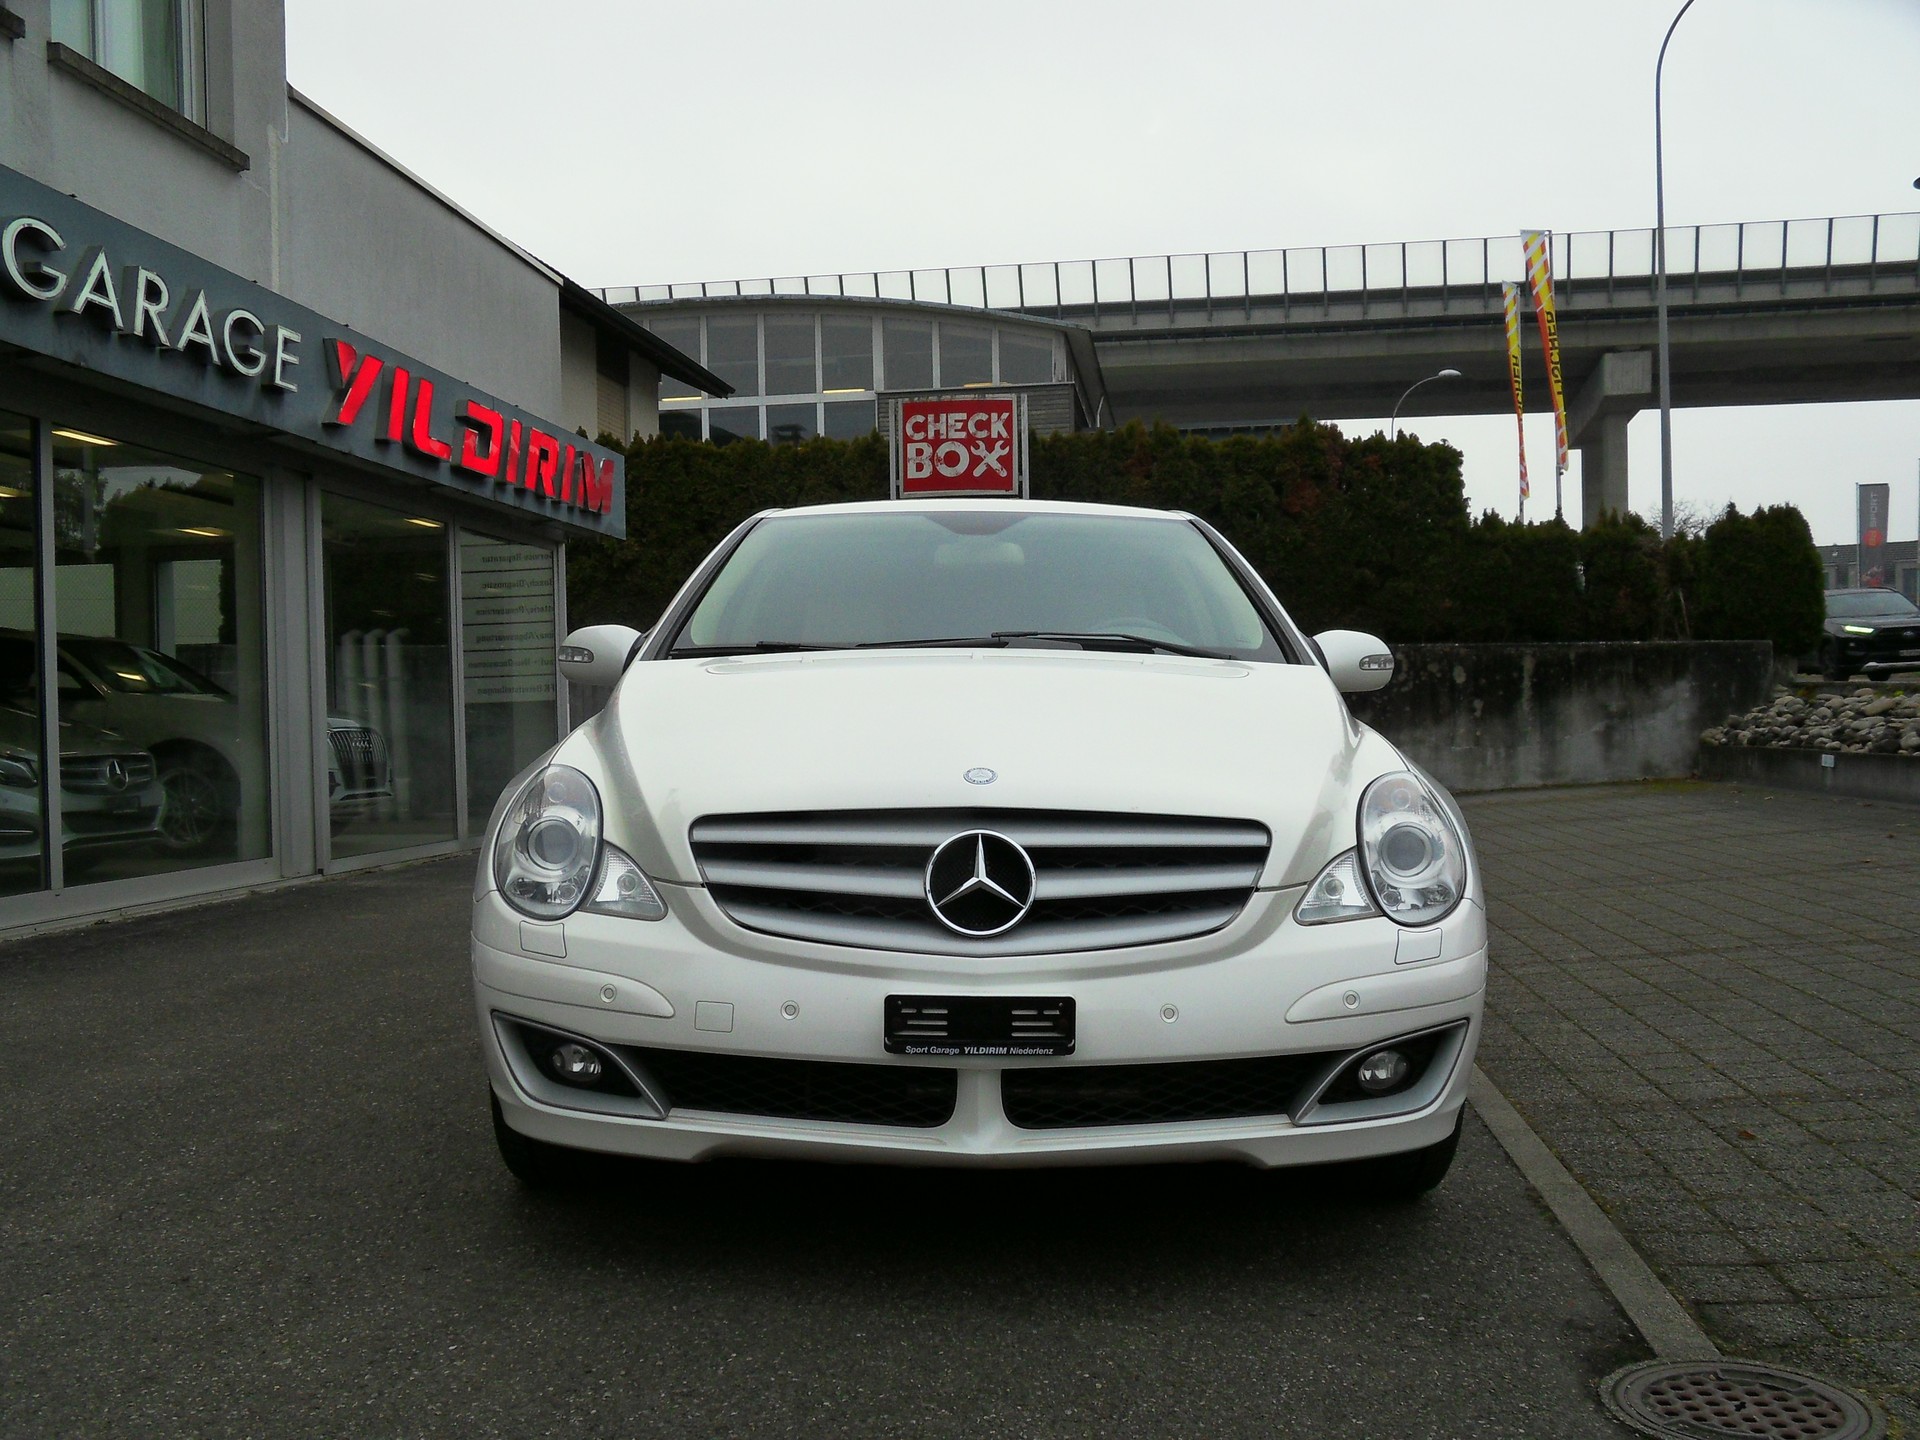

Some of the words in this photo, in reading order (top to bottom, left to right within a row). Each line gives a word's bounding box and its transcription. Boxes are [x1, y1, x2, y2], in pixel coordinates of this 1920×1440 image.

[2, 217, 301, 393] GARAGE
[323, 337, 615, 515] YILDIRIM
[905, 412, 1010, 441] CHECK
[905, 1045, 928, 1055] Sport
[929, 1045, 960, 1056] Garage
[963, 1046, 1008, 1055] YILDIRIM
